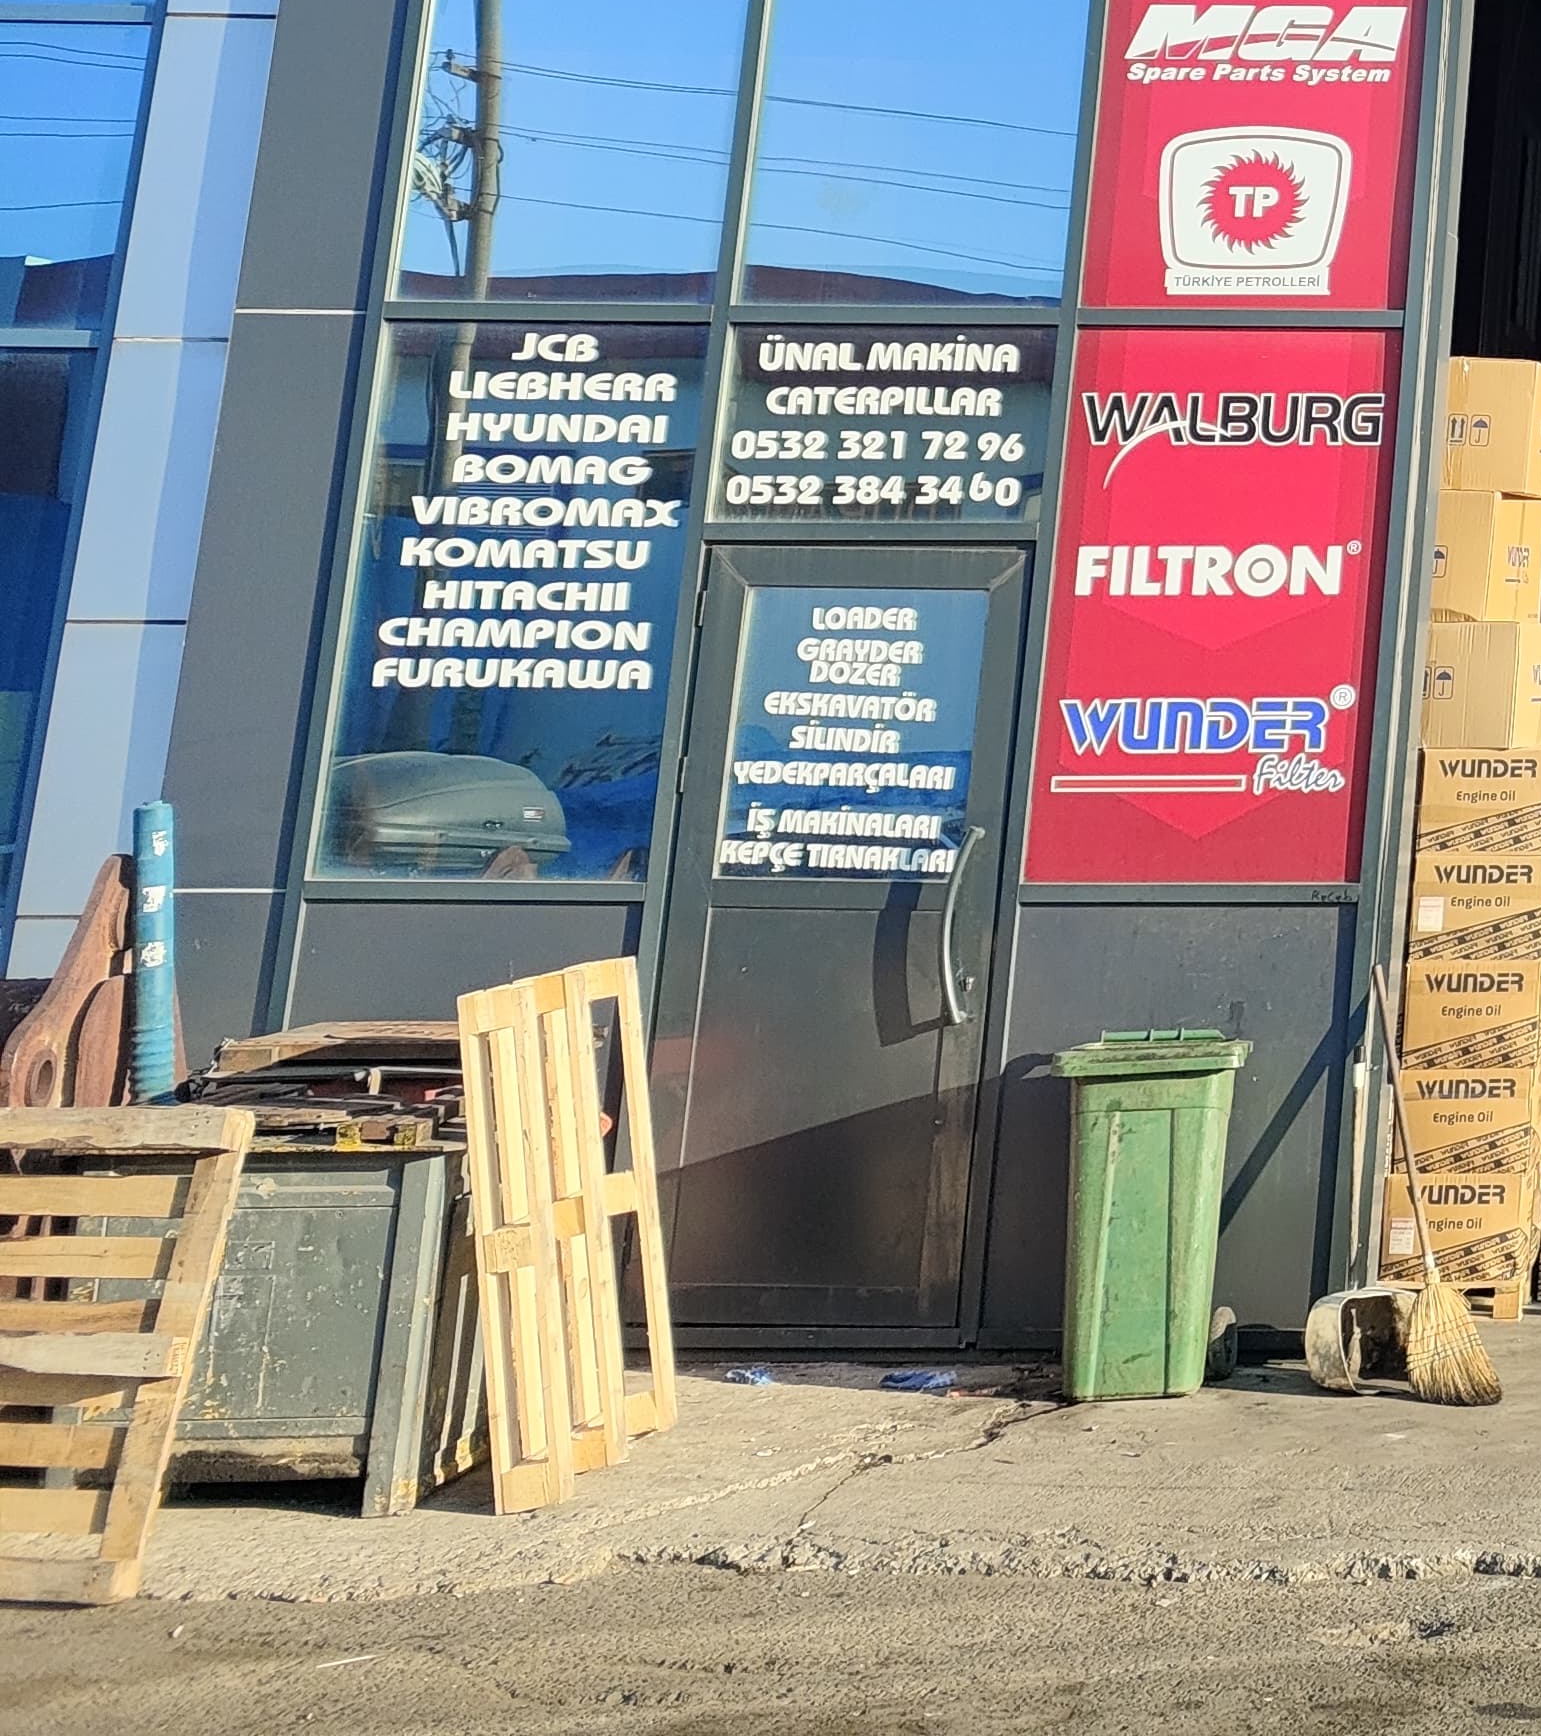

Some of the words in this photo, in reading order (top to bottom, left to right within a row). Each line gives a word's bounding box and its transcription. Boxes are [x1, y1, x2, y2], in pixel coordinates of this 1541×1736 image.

[1124, 3, 1408, 62] MGA
[1126, 62, 1205, 85] Spare
[1212, 63, 1285, 82] Parts
[1293, 64, 1391, 87] System
[1229, 186, 1279, 218] TP
[1174, 273, 1232, 287] TÜRKİYE
[1236, 273, 1321, 288] PETROLLERİ
[511, 333, 600, 363] JCB
[758, 334, 865, 372] ÜNAL
[866, 334, 1021, 373] MAKİNA
[448, 370, 678, 402] LIEBHERR
[765, 386, 1004, 417] CATERPILLAR
[445, 412, 669, 444] HYUNDAI
[1081, 391, 1385, 447] WALBURG
[731, 430, 828, 461] 0532
[837, 430, 907, 461] 321
[921, 430, 970, 461] 72
[976, 432, 1025, 462] 96
[451, 454, 654, 486] BOMAG
[726, 475, 824, 506] 0532
[832, 475, 907, 506] 384
[915, 475, 965, 506] 34
[969, 471, 1021, 507] 60
[411, 495, 683, 528] VIBROMAX
[400, 537, 651, 571] KOMATSU
[1074, 543, 1343, 598] FILTRON
[377, 617, 652, 651] CHAMPION
[812, 606, 919, 631] LOADER
[796, 637, 924, 665] GRAYDER
[371, 657, 653, 690] FURUKAWA
[809, 660, 902, 688] DOZER
[763, 691, 937, 722] EKSKAVATÖR
[1059, 698, 1327, 755] WUNDER
[733, 761, 956, 794] YEDEKPARÇALARI
[1253, 752, 1345, 795] Filter
[1439, 758, 1538, 778] WUNDER
[1456, 790, 1497, 804] Engine
[1499, 790, 1516, 801] Oil
[747, 801, 777, 839] İŞ
[777, 805, 942, 840] MAKİNALARI
[719, 840, 805, 873] KEPÇE
[807, 844, 959, 873] TIRNAKLARI
[1434, 864, 1534, 884] WUNDER
[1450, 895, 1491, 911] Engine
[1494, 895, 1511, 908] Oil
[1425, 972, 1525, 993] WUNDER
[1441, 1006, 1483, 1019] Engine
[1485, 1005, 1501, 1016] Oil
[1415, 1078, 1517, 1099] WUNDER
[1433, 1111, 1474, 1125] Engine
[1477, 1111, 1494, 1123] Oil
[1426, 1218, 1464, 1232] ngine
[1466, 1217, 1482, 1230] Oil
